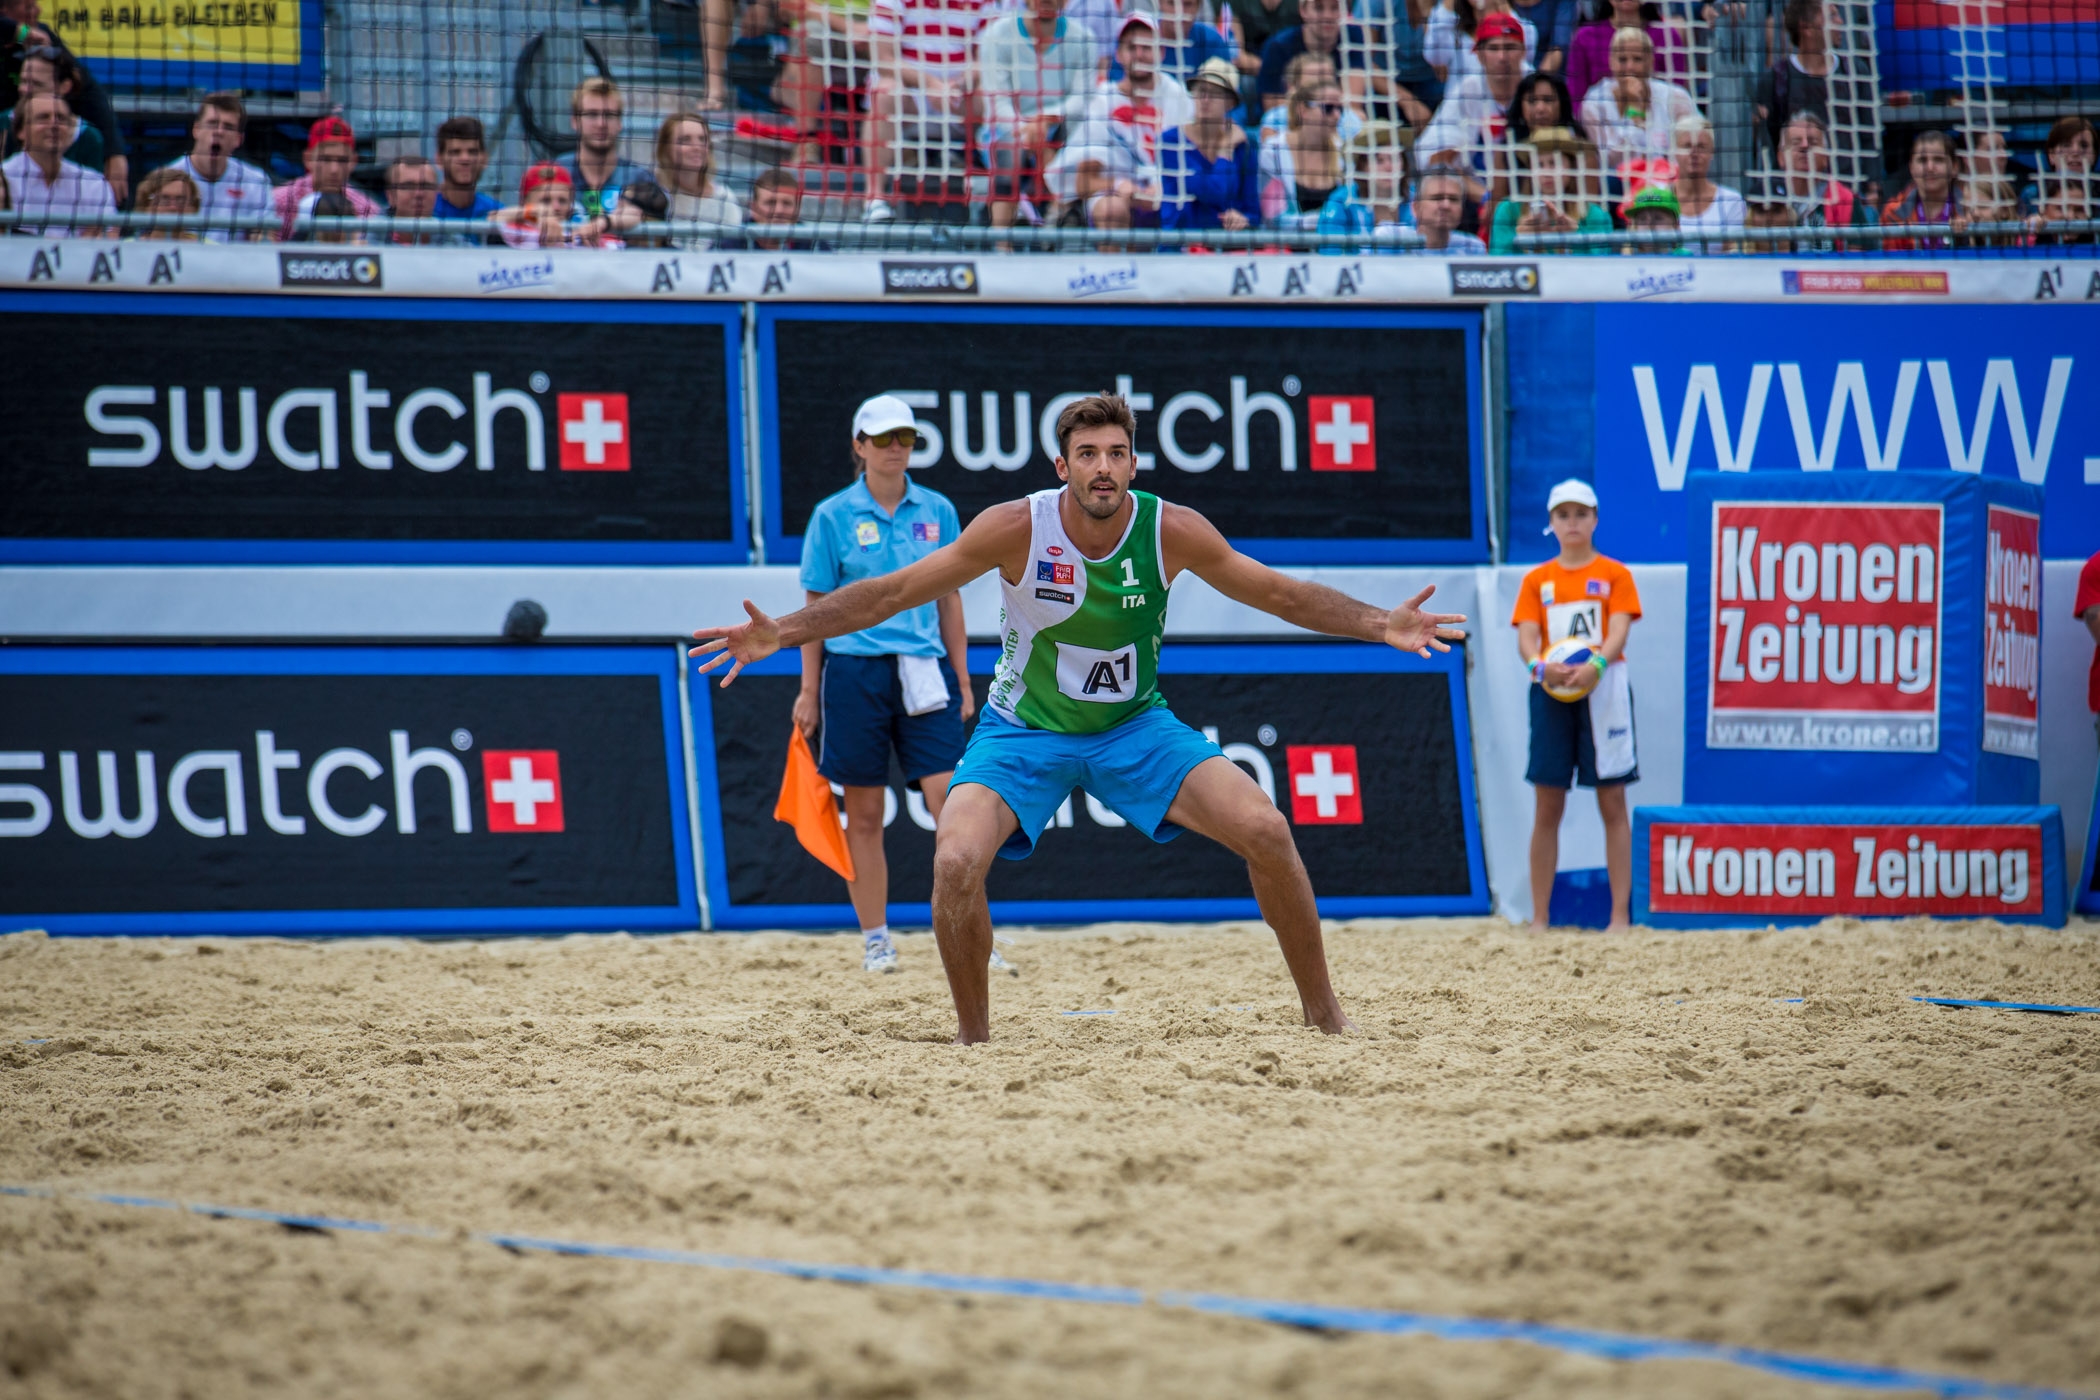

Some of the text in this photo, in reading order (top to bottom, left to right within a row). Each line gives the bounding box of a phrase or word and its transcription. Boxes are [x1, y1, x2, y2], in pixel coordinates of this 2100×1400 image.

[57, 4, 277, 31] AM BALL BLEIBEN
[286, 257, 349, 281] smart
[888, 266, 949, 288] smart
[1455, 267, 1514, 289] smart
[84, 370, 546, 472] swatch
[1120, 558, 1140, 587] 1
[1720, 526, 1936, 605] Kronen
[1039, 590, 1066, 600] swatch
[1122, 594, 1146, 609] ITA
[1716, 605, 1935, 694] Zeitung
[1082, 652, 1131, 695] A1
[1715, 718, 1932, 746] www.krone.at
[0, 730, 472, 838] swatch
[1662, 835, 2029, 905] Kronen Zeitung
